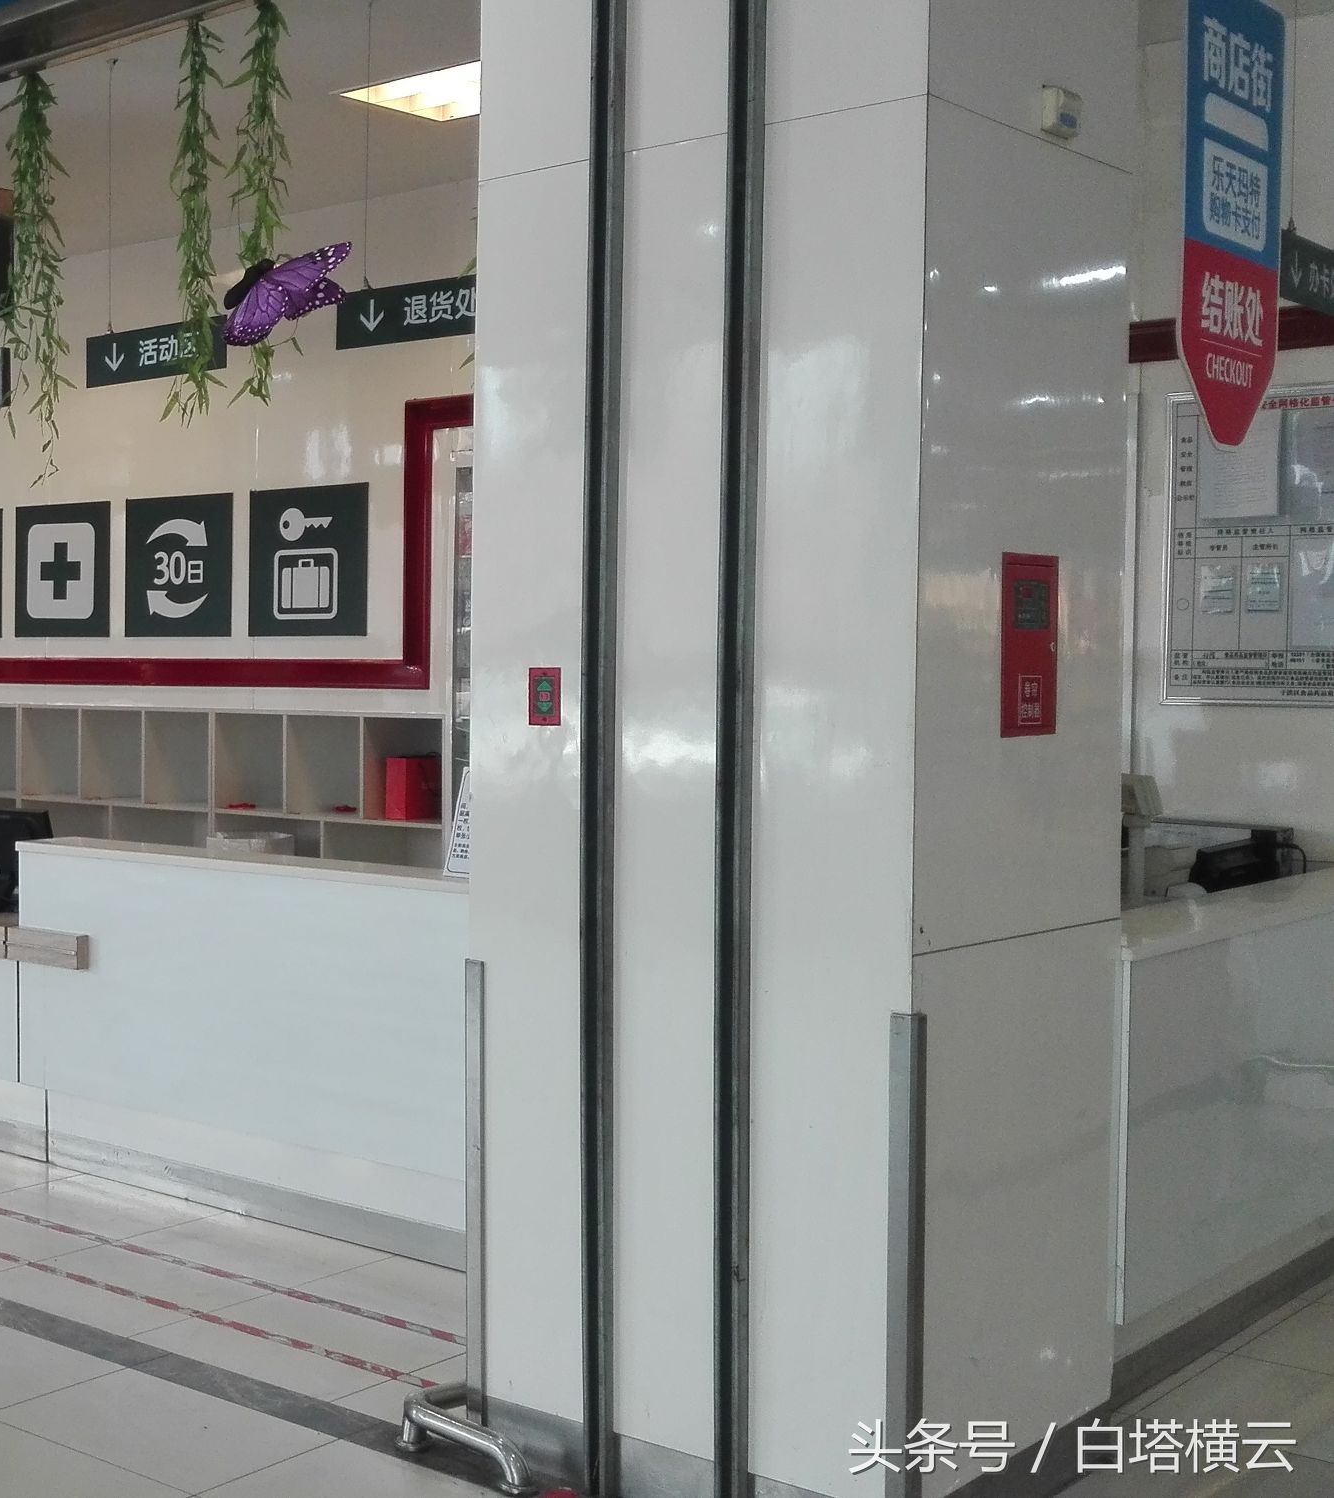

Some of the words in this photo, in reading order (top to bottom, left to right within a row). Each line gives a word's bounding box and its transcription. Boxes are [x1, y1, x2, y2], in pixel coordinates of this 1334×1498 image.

[1202, 16, 1274, 113] 商店街
[1212, 155, 1262, 209] 乐天玛特
[1209, 190, 1262, 241] 购物卡支付
[1309, 261, 1334, 304] 办卡
[403, 287, 476, 326] 退货处
[1200, 271, 1264, 348] 结账处
[1205, 352, 1255, 389] CHECKOUT
[1262, 395, 1334, 409] 全网格化监管
[154, 550, 204, 585] 30日
